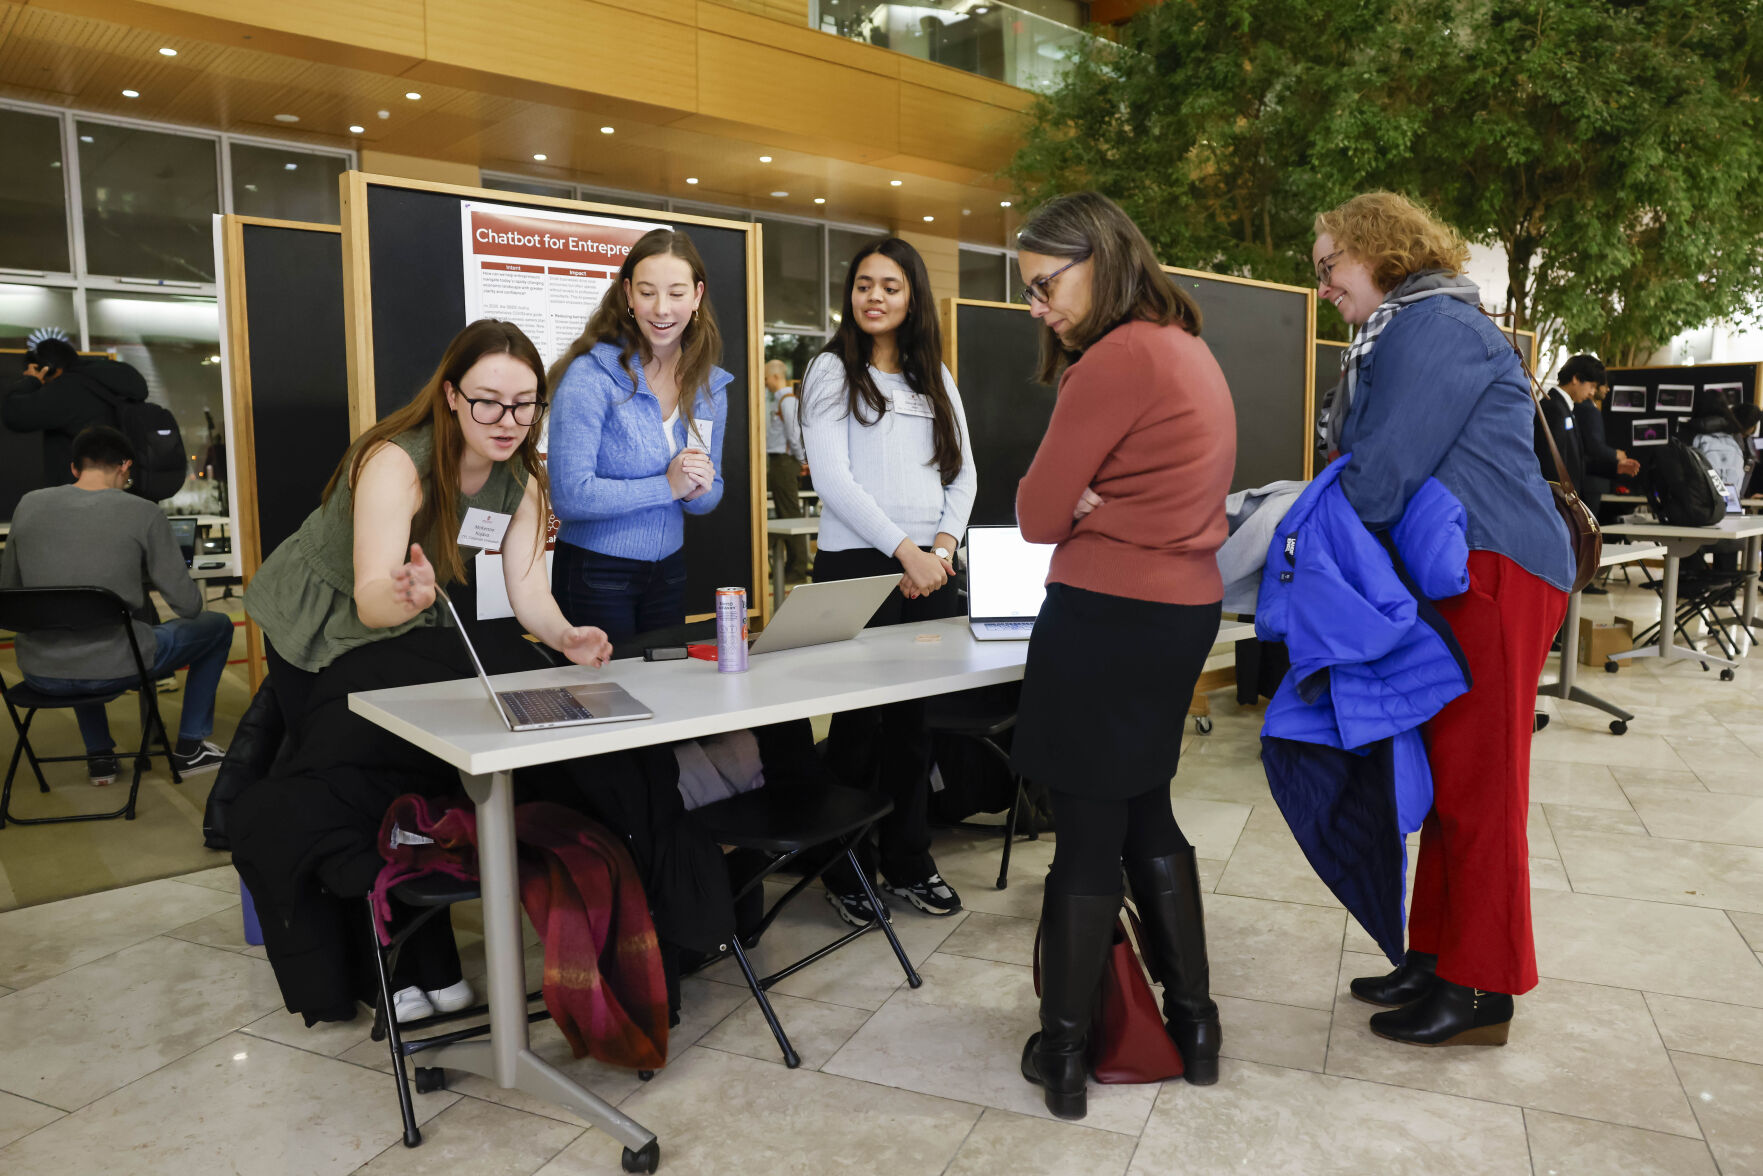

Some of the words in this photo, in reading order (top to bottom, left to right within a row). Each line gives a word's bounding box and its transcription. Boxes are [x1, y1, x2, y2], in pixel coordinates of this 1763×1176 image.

[476, 228, 541, 247] Chatbot
[543, 234, 566, 250] for
[569, 237, 632, 257] Entrepre
[569, 269, 587, 277] Impact
